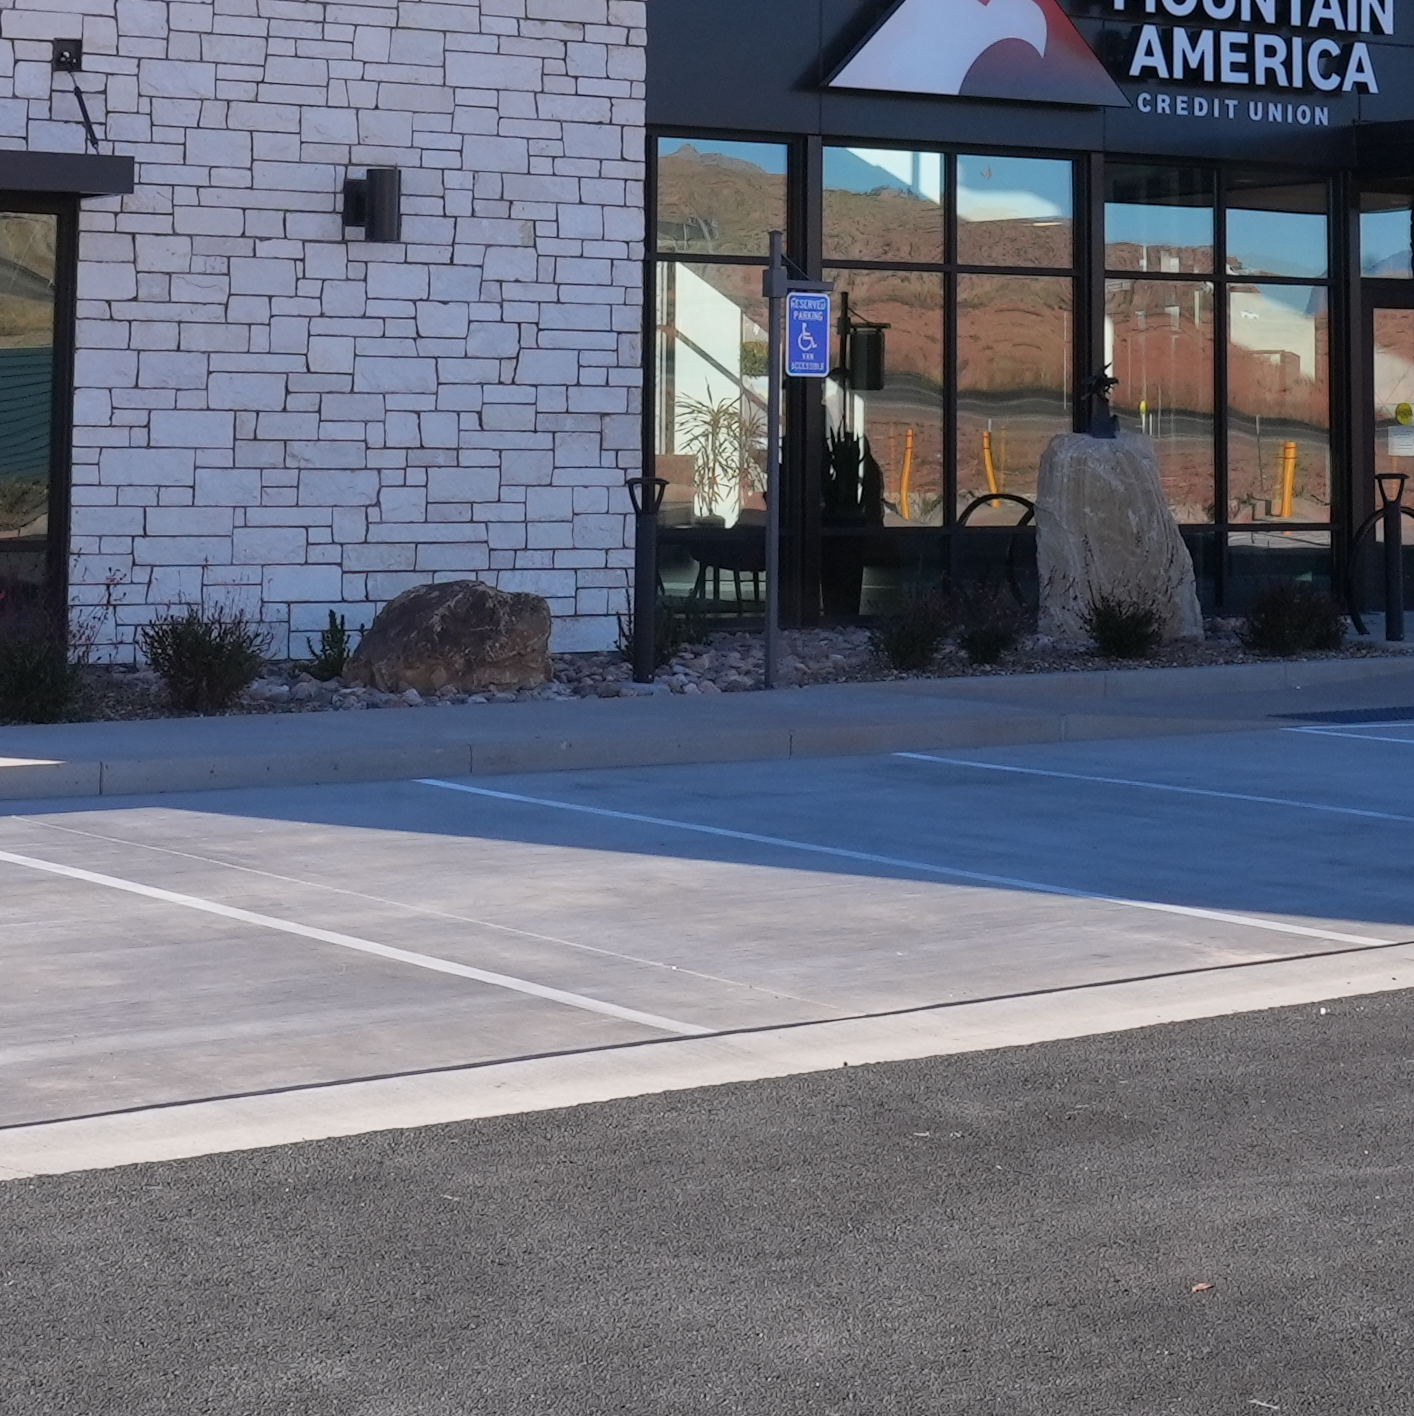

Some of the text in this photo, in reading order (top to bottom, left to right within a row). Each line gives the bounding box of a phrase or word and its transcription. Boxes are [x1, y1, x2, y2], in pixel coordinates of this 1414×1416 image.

[1128, 23, 1380, 95] AMERICA
[1137, 92, 1329, 126] CREDIT UNION
[790, 297, 826, 310] RESERVED
[793, 310, 823, 322] PARKING
